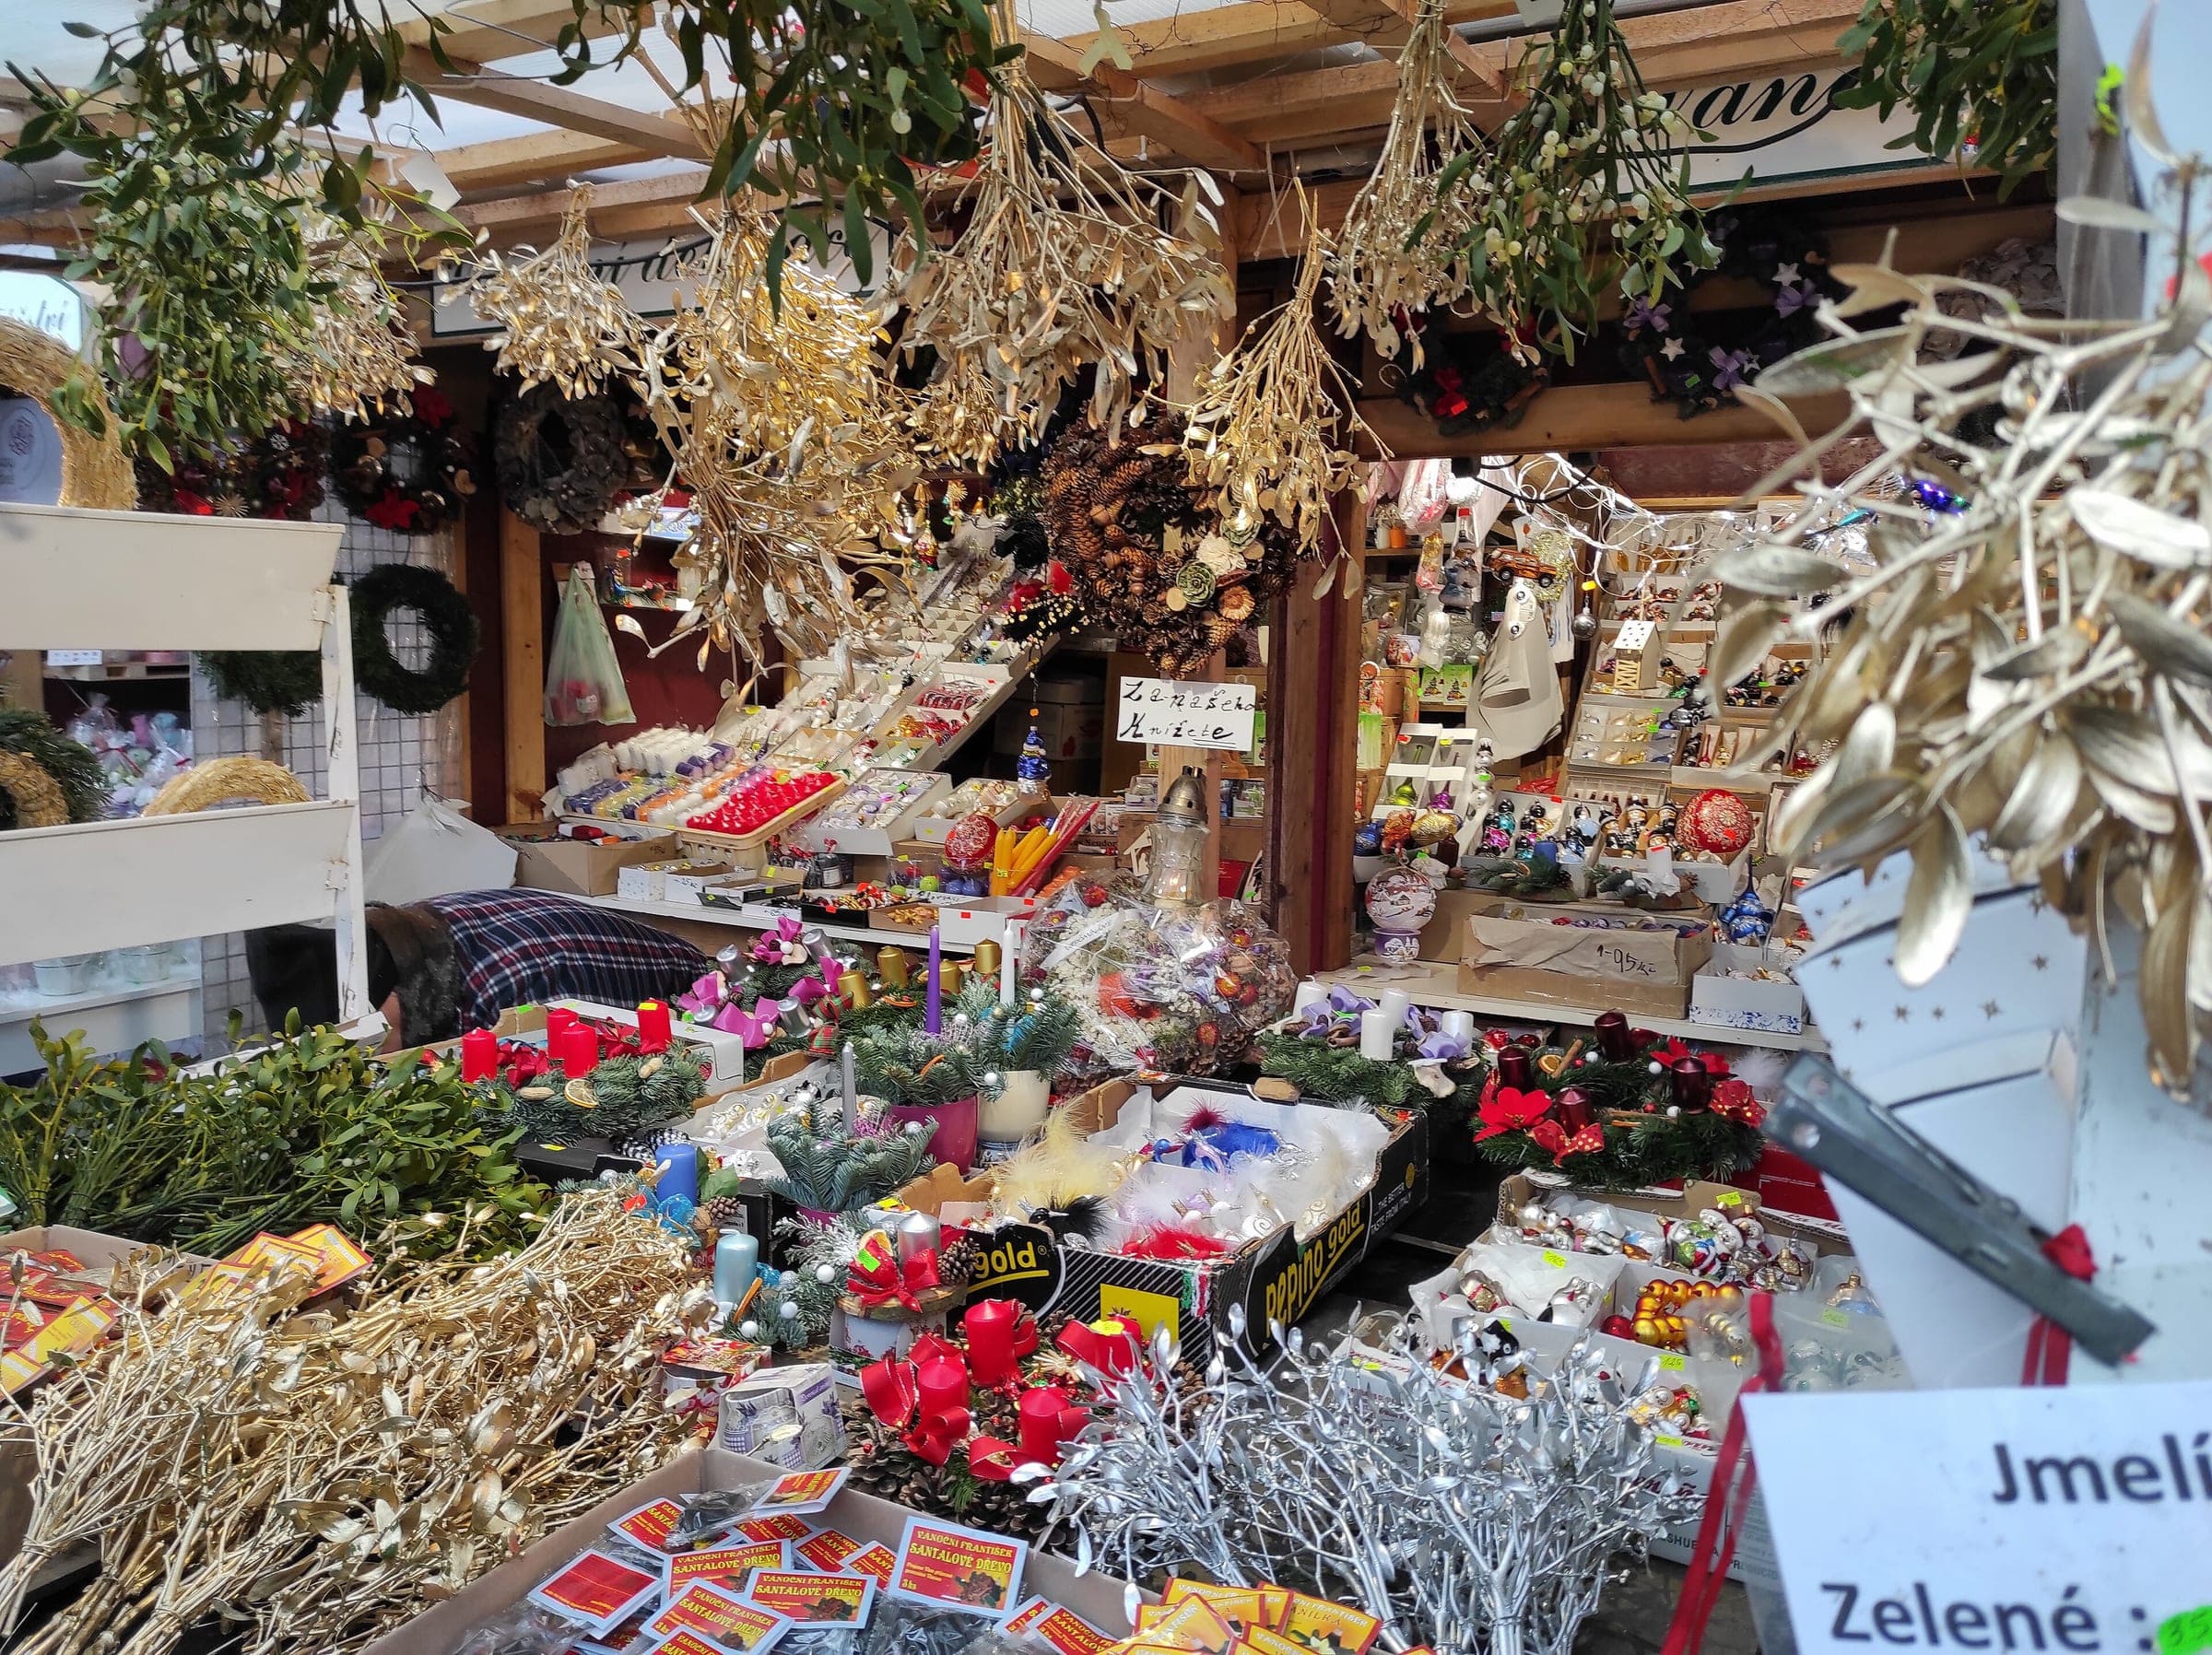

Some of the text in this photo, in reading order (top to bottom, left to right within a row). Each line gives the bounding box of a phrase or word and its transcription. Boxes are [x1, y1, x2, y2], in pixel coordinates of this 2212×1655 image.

[1120, 712, 1233, 740] Knížete
[973, 1241, 1037, 1279] gold
[1327, 1201, 1361, 1260] gold
[1991, 1431, 2212, 1506] Jmelí
[1819, 1581, 2100, 1652] Zelené
